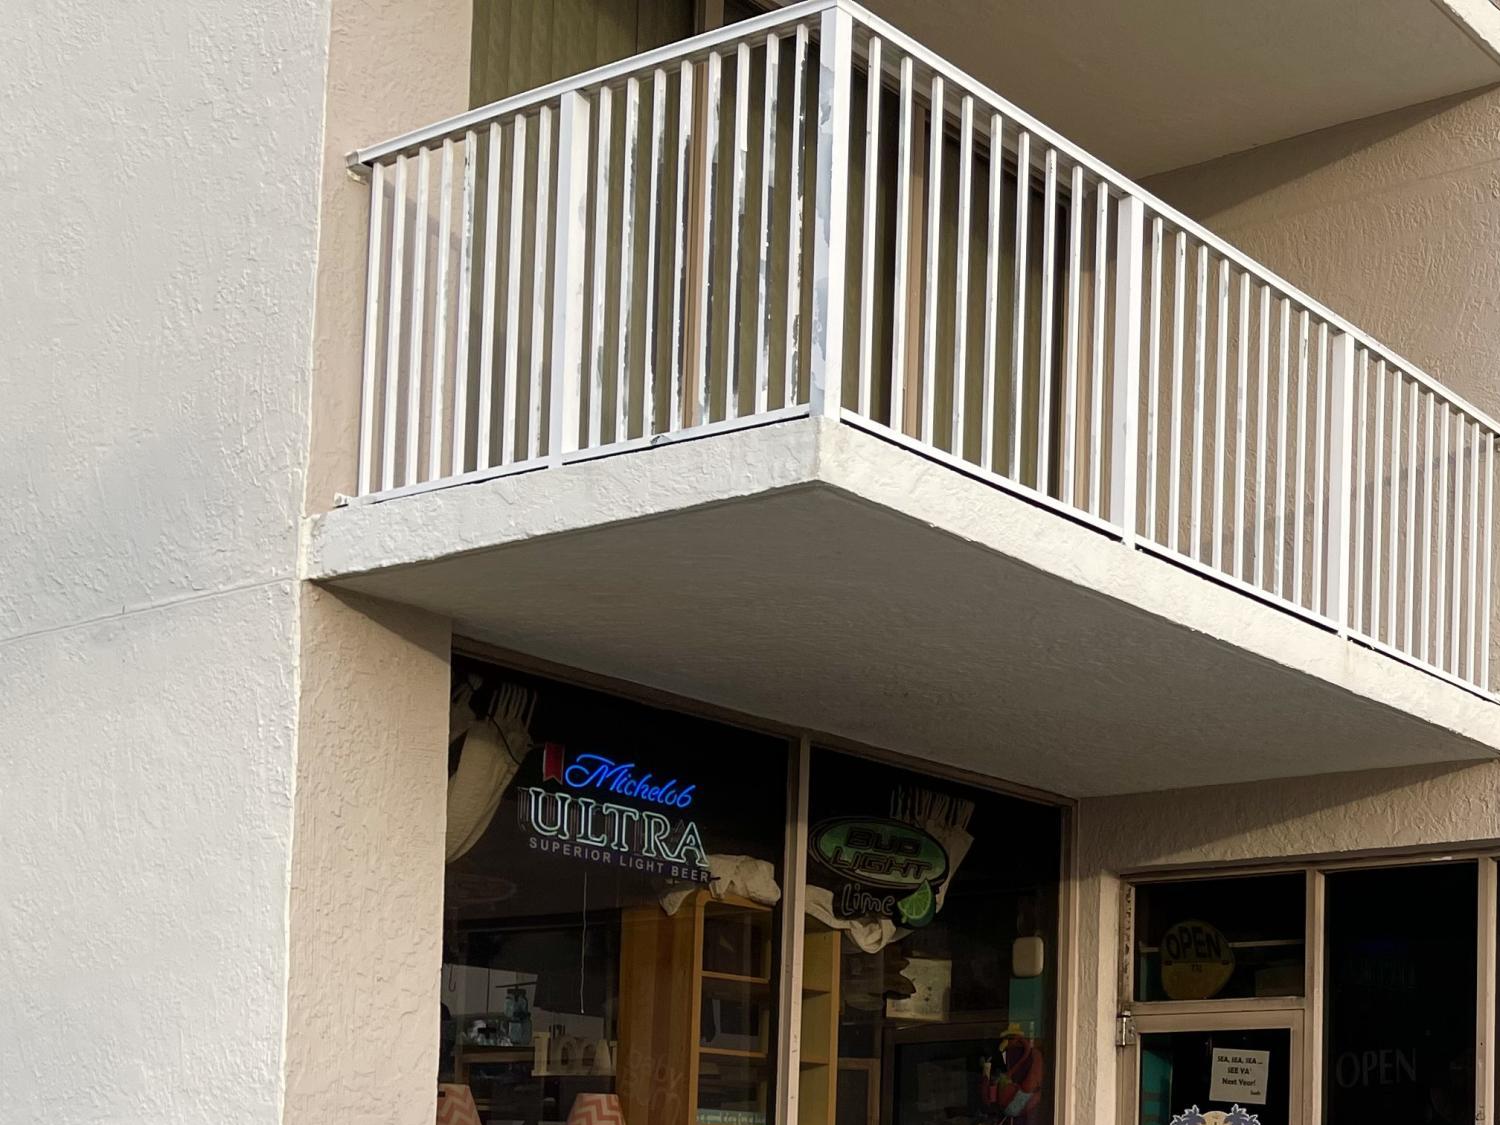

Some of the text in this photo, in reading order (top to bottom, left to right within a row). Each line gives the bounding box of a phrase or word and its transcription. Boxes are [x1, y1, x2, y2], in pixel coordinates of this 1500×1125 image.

[564, 753, 696, 808] Michelob
[528, 787, 710, 867] ULTRA
[846, 826, 921, 856] BUD
[529, 836, 709, 883] SUPERIOR LIGHT BEER
[830, 846, 932, 879] LIGHT
[1166, 926, 1222, 960] OPEN
[1335, 1047, 1417, 1088] OPEN
